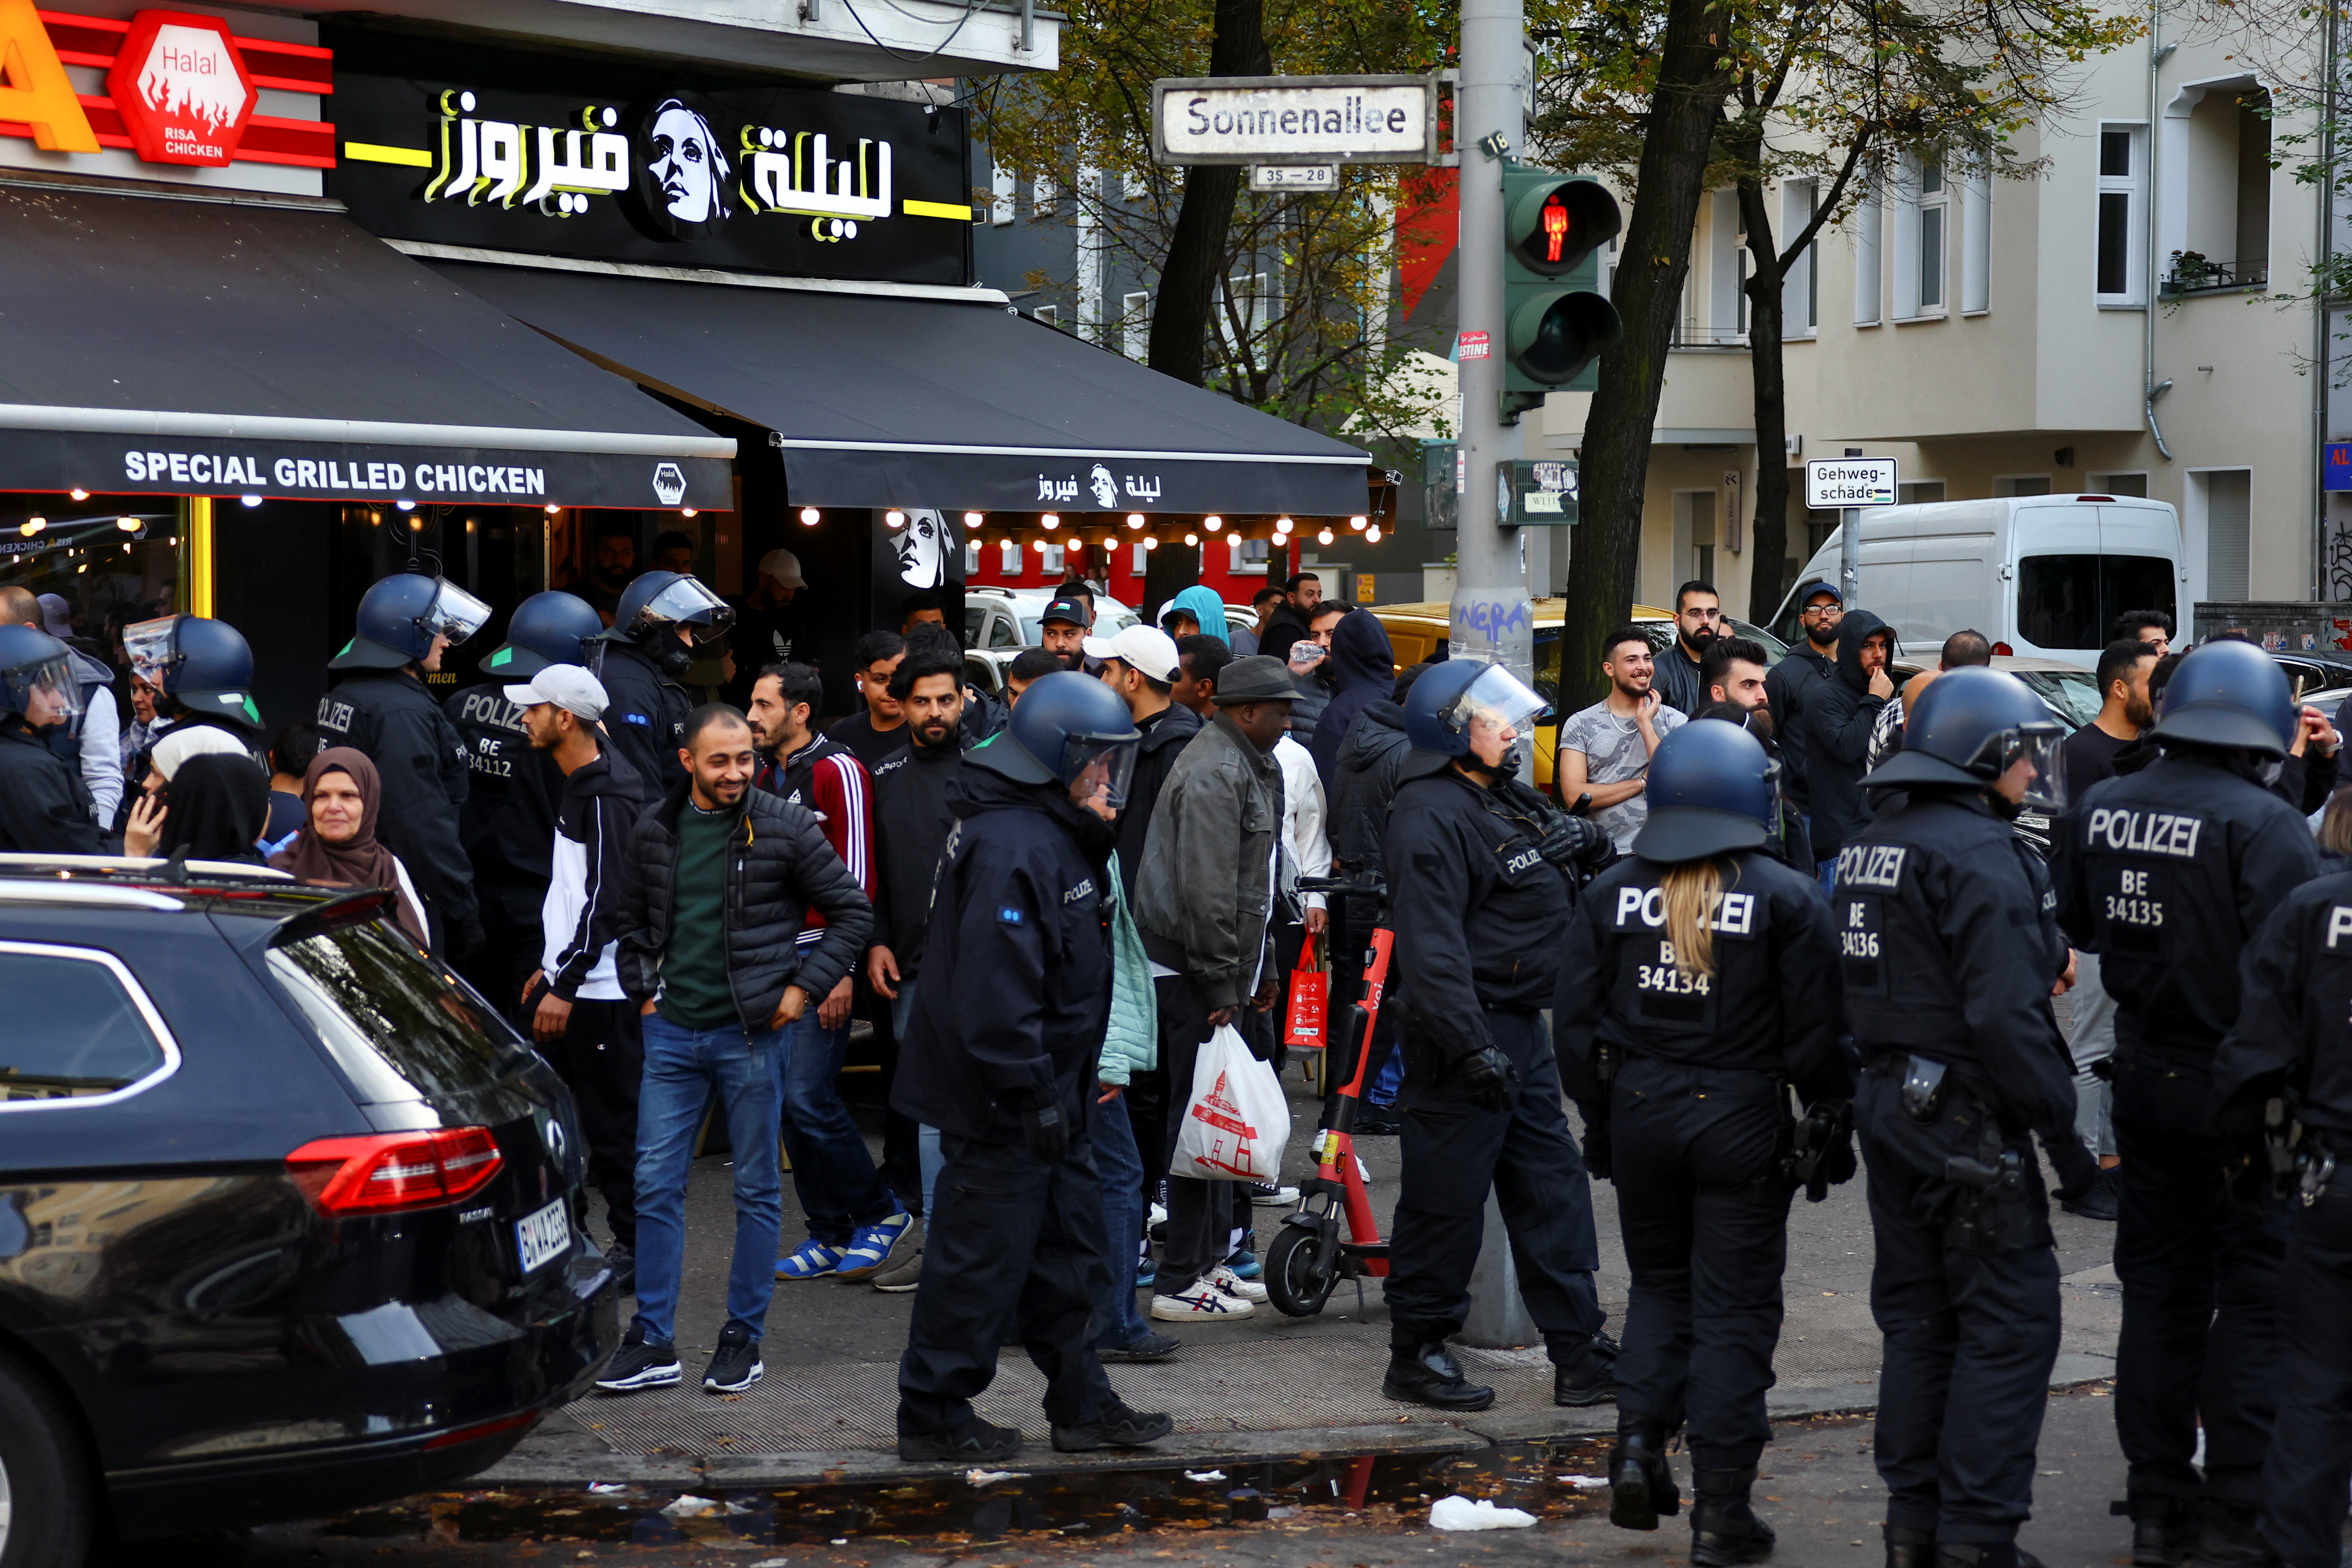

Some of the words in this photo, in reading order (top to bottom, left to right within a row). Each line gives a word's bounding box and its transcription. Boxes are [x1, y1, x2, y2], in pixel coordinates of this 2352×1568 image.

[163, 45, 217, 76] Halal
[1187, 96, 1406, 135] Sonnenallee
[165, 127, 197, 142] RISA
[1487, 133, 1508, 153] 18
[165, 141, 222, 159] CHICKEN
[440, 91, 629, 213] فيروز
[747, 127, 892, 239] ليلة
[1267, 169, 1284, 181] 35
[1307, 169, 1325, 181] 28
[125, 451, 267, 485] SPECIAL
[274, 458, 406, 490] GRILLED
[415, 464, 545, 495] CHICKEN
[1818, 467, 1886, 483] Gehweg-
[1037, 473, 1079, 502] فيروز
[1125, 475, 1161, 503] ليلة
[1821, 485, 1882, 499] schäde
[461, 694, 529, 734] POLIZ
[479, 738, 502, 756] BE
[469, 753, 511, 777] 34112
[2088, 808, 2201, 858] POLIZEI
[1834, 845, 1906, 888] POLIZEI
[2121, 869, 2148, 897] BE
[1849, 902, 1865, 928] BE
[2106, 896, 2163, 927] 34135
[1840, 931, 1879, 958] 34136
[1638, 965, 1710, 995] 34134
[522, 1225, 531, 1264] B
